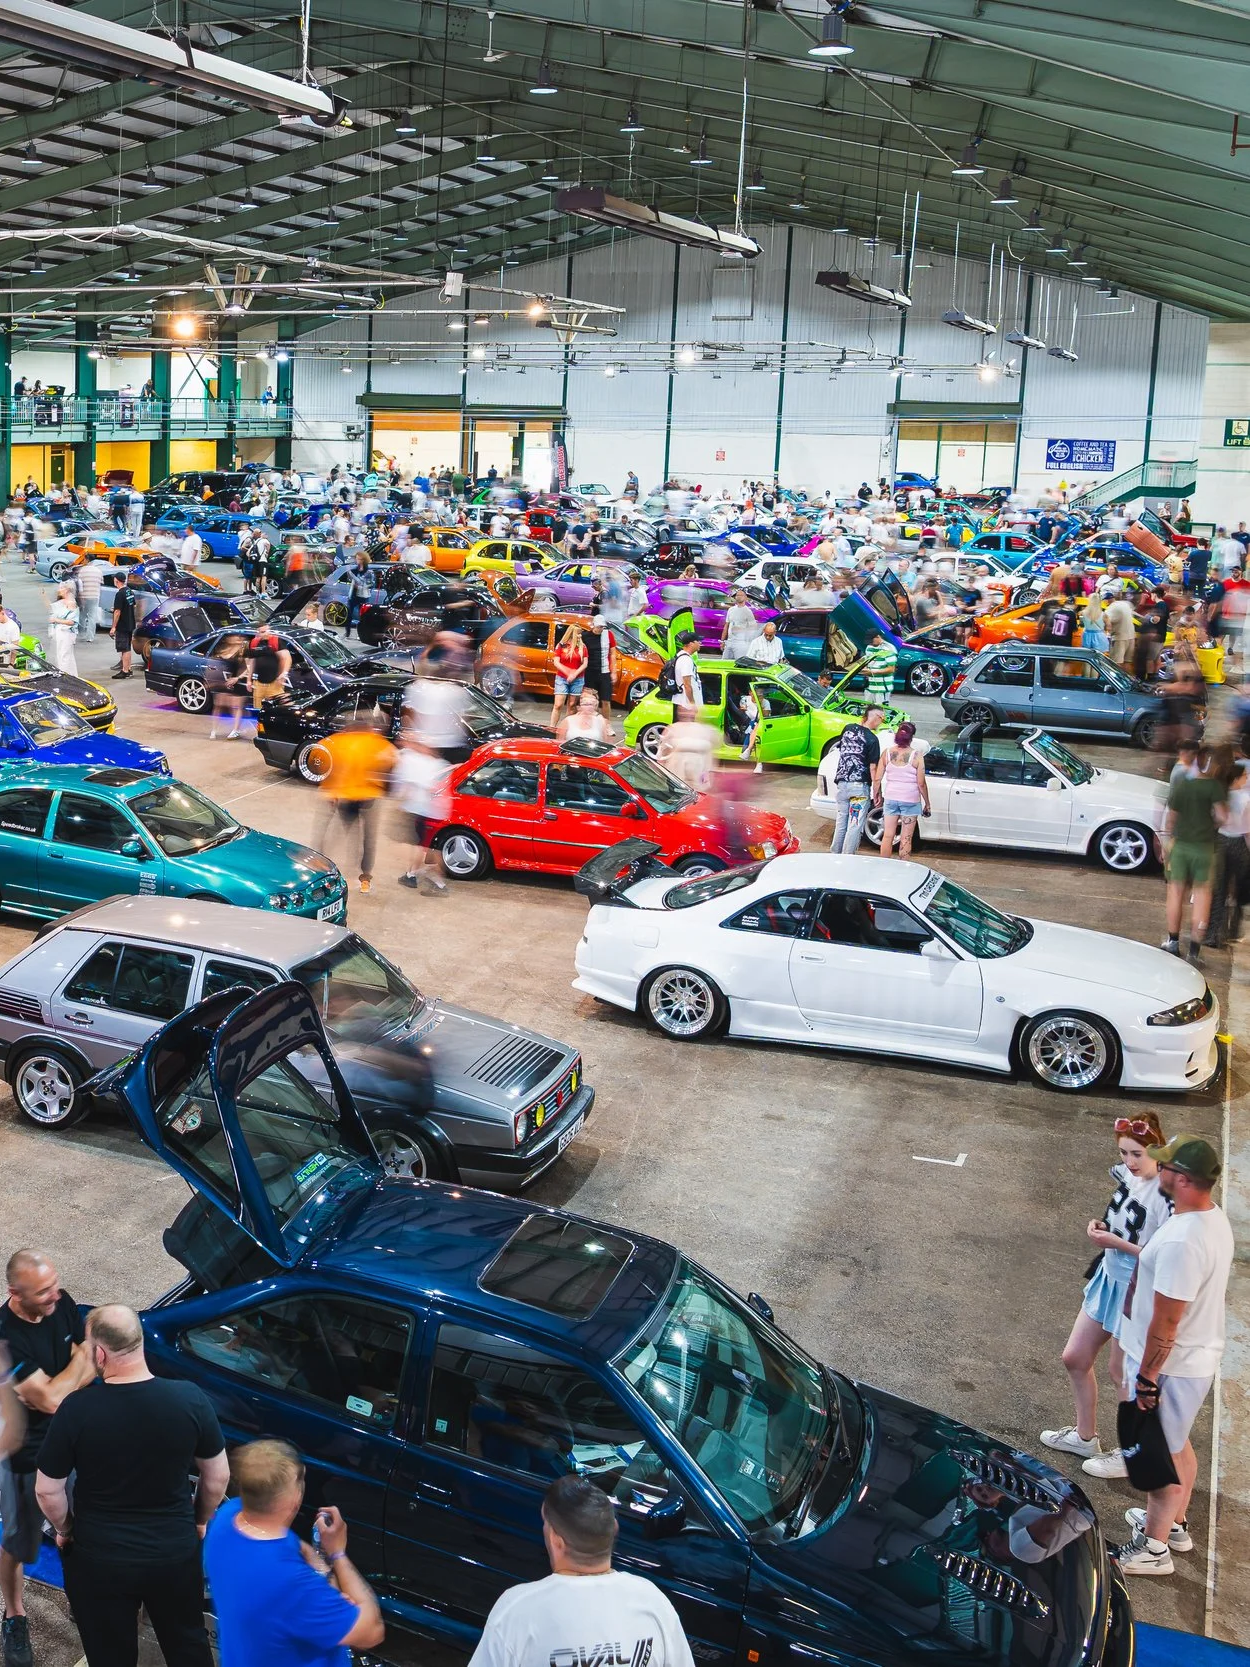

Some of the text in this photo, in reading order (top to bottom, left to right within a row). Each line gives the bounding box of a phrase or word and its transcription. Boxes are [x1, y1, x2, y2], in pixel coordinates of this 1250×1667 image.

[1226, 438, 1242, 446] LIFT
[1076, 453, 1104, 463] CHICKEN
[296, 1160, 320, 1182] HENLYS
